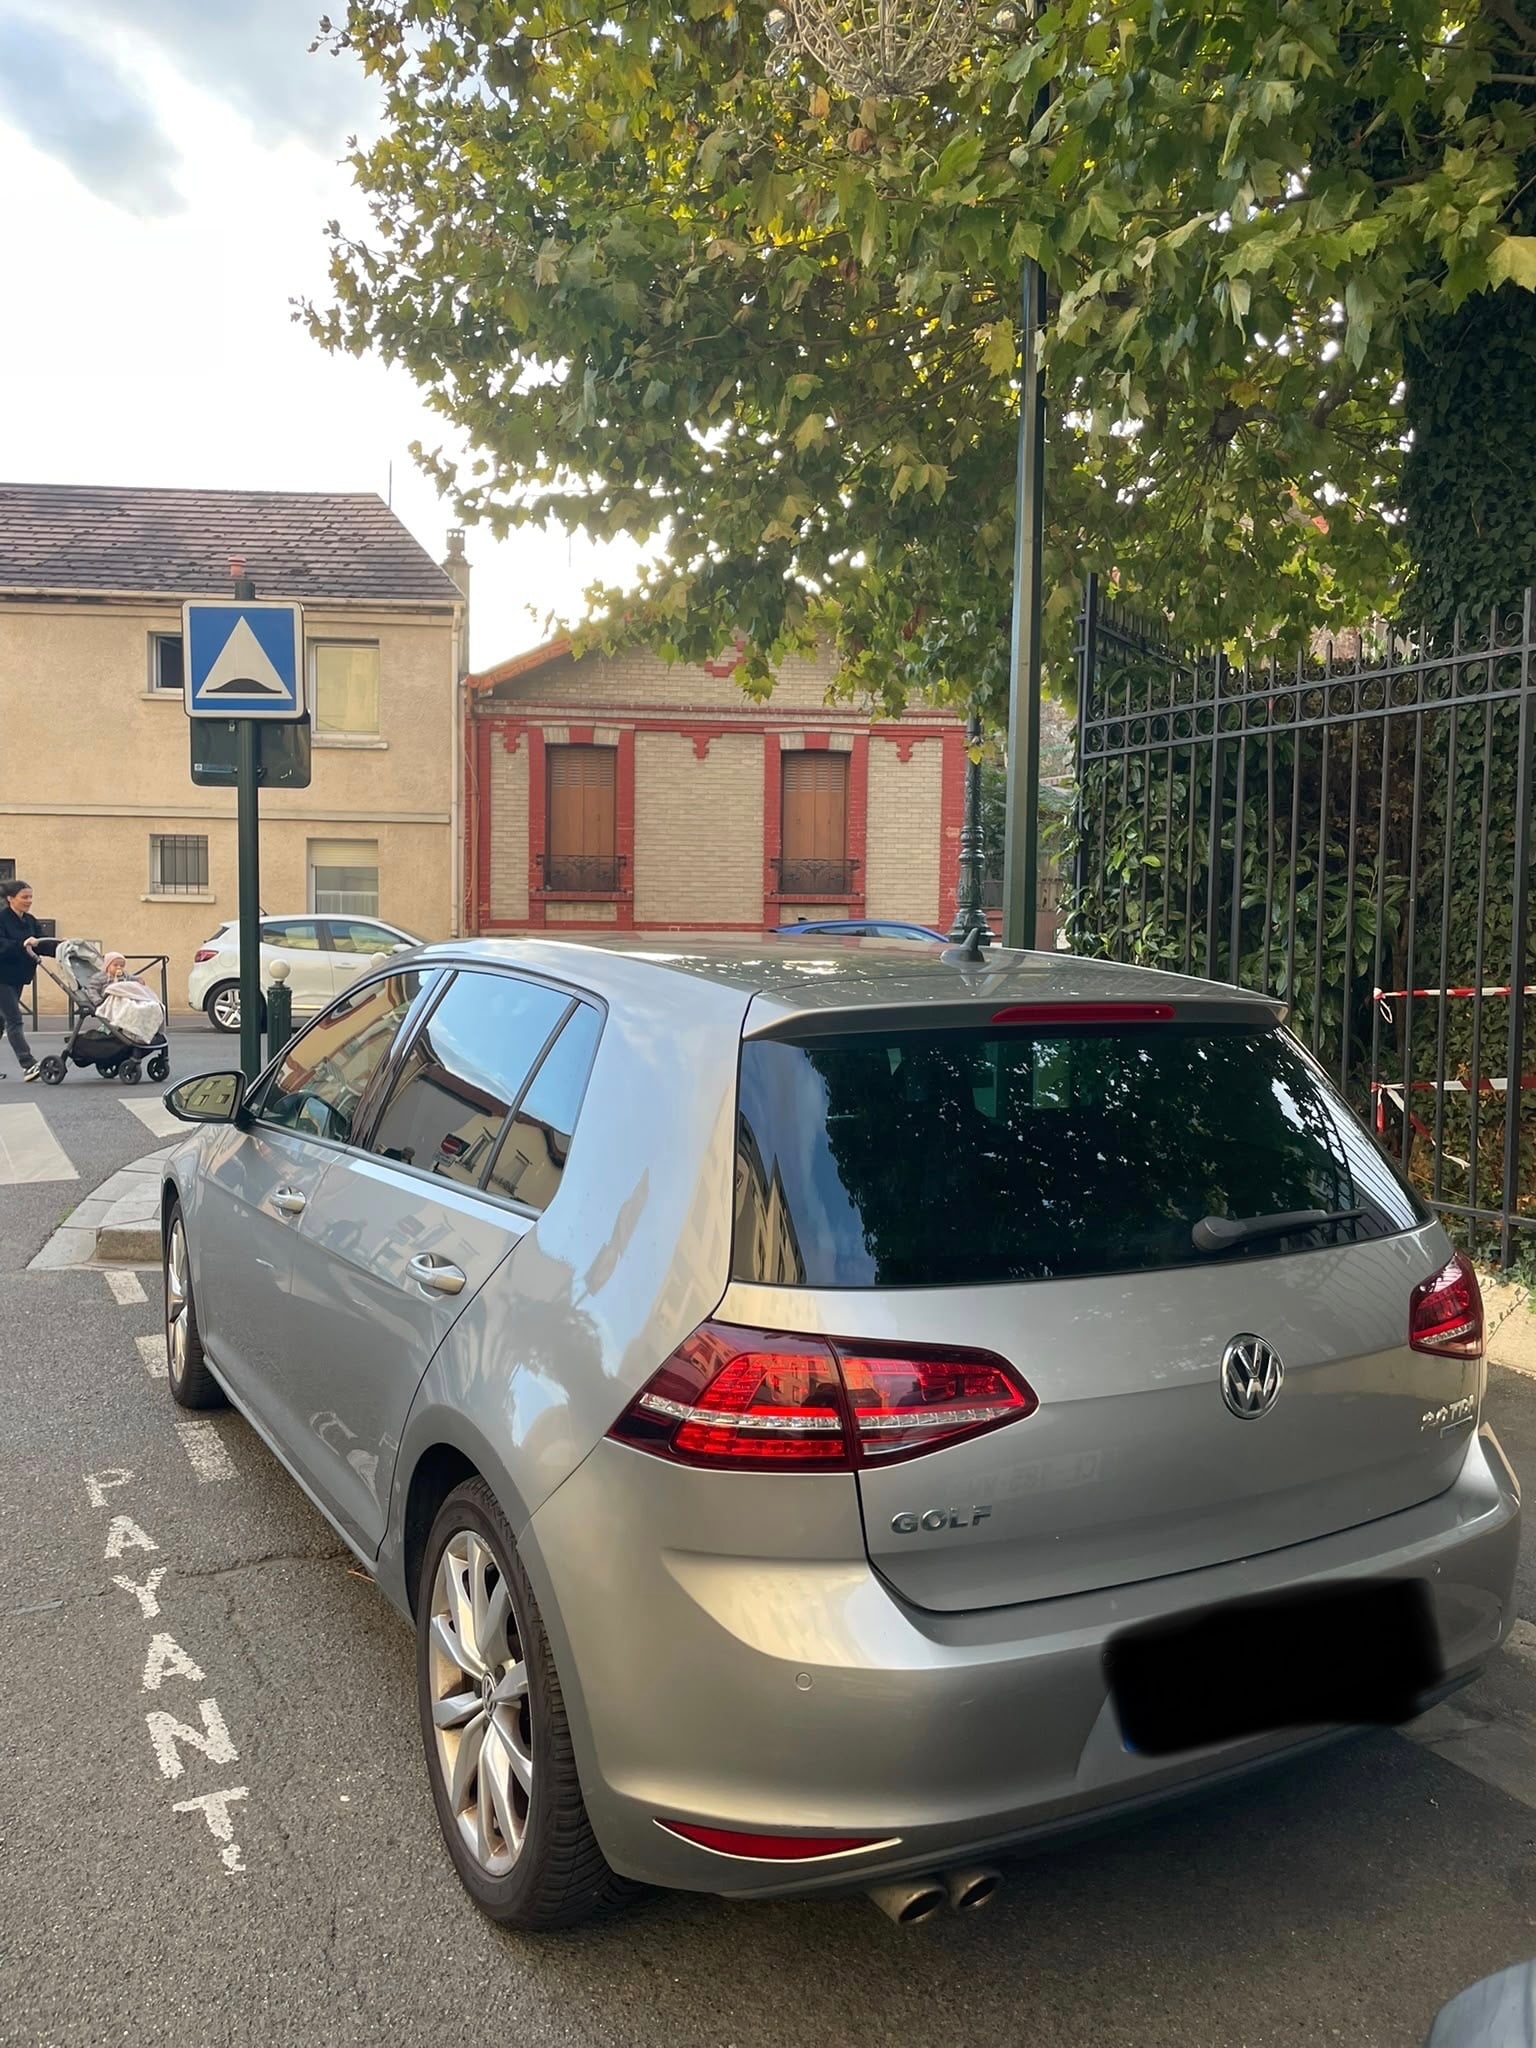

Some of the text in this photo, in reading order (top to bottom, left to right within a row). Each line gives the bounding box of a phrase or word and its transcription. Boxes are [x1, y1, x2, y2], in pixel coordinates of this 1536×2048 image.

[1223, 1335, 1283, 1416] VW
[890, 1504, 993, 1535] GOLF
[83, 1467, 250, 1874] PAYANT
